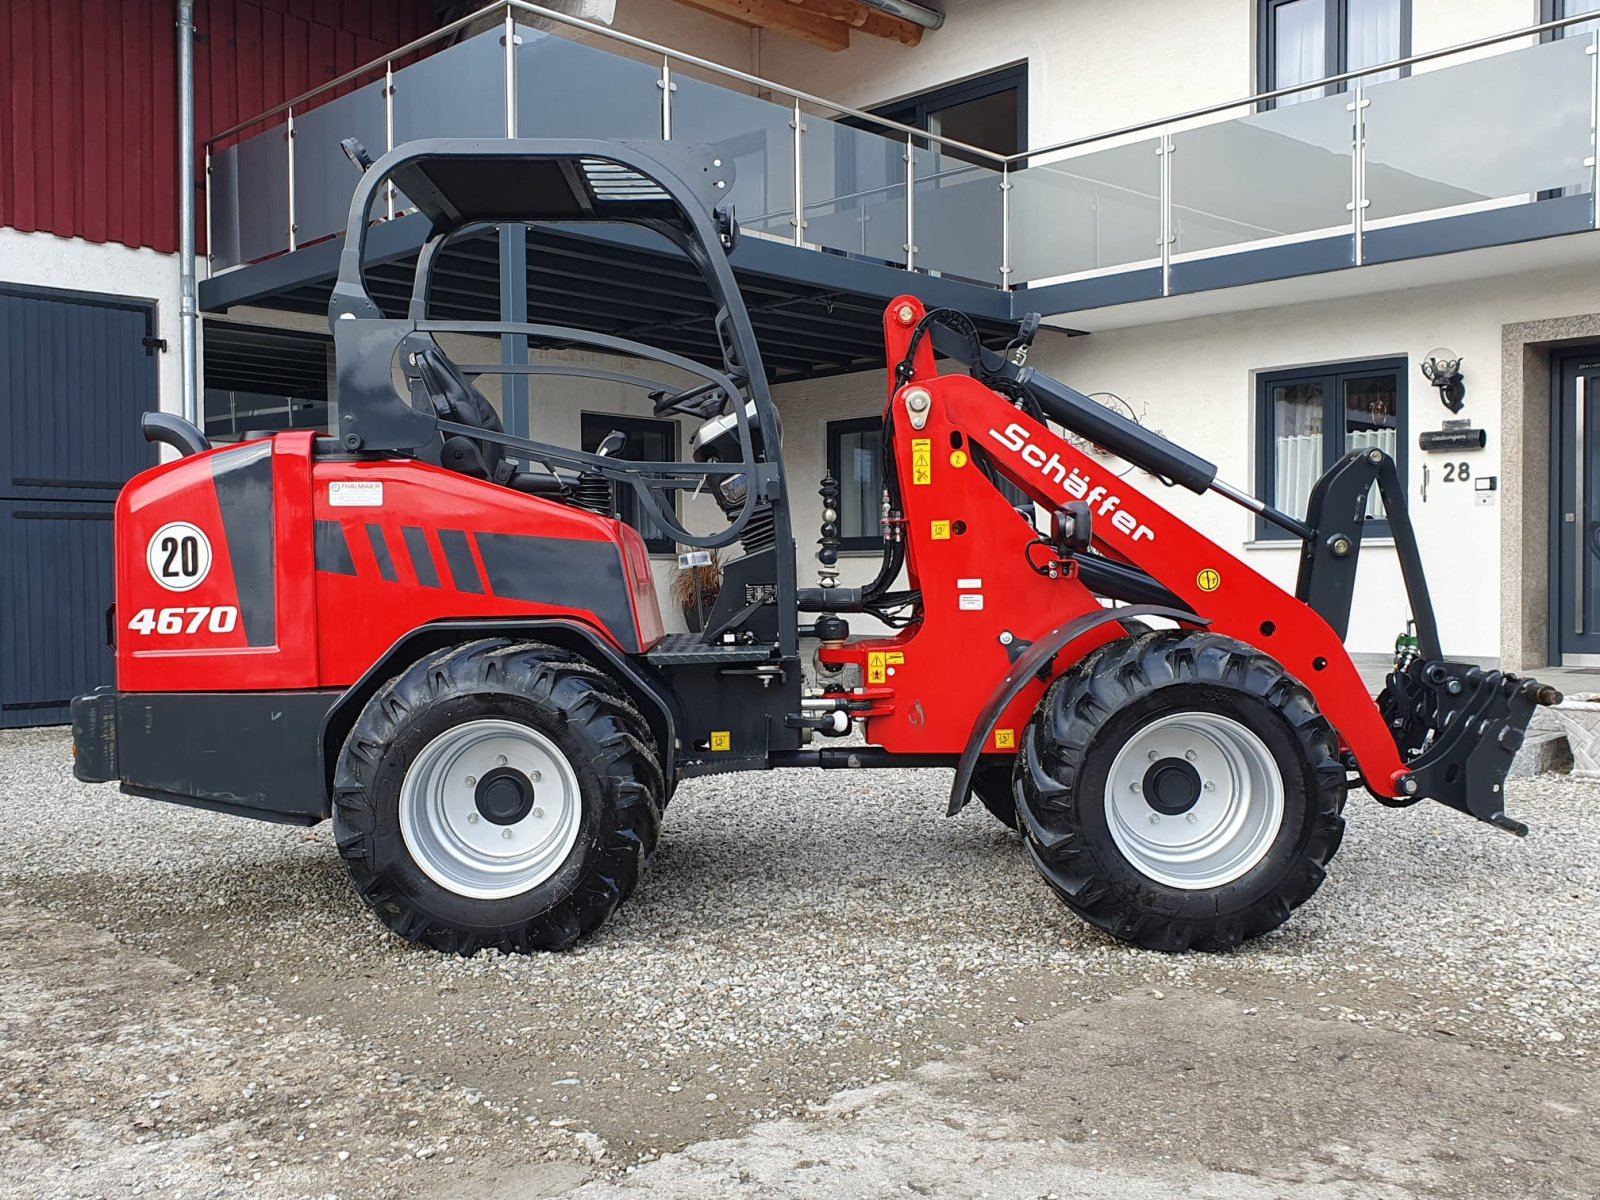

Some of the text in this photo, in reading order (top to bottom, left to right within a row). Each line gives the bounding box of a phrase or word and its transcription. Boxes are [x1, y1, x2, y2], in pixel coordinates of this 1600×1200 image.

[988, 423, 1155, 541] Schäffer
[1443, 462, 1470, 483] 28
[161, 536, 199, 577] 20
[128, 606, 238, 635] 4670
